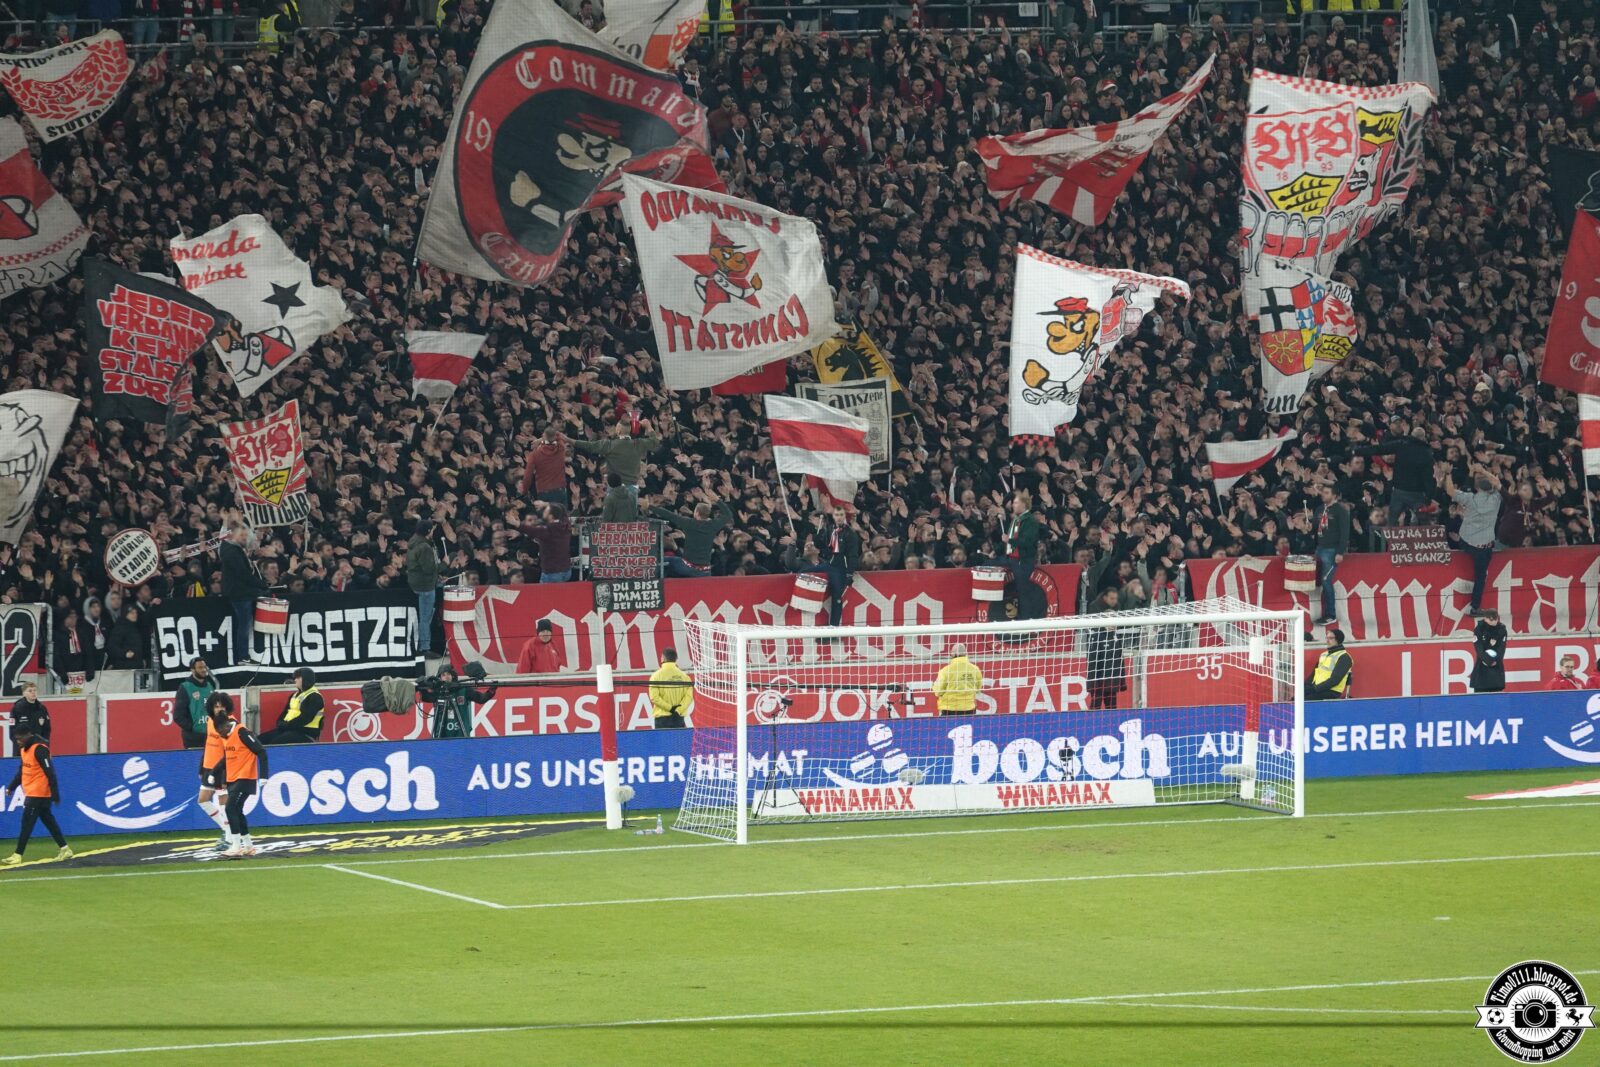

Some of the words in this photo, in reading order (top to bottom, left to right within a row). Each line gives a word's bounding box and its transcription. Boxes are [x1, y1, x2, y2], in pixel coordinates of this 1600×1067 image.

[109, 284, 215, 337] JEDER
[591, 531, 657, 546] VERBANNTE
[599, 522, 650, 533] JEDER
[1383, 528, 1423, 540] ULTRA
[1426, 528, 1447, 539] IST
[598, 546, 651, 556] KEHRT
[1391, 553, 1414, 565] UMS
[1415, 552, 1453, 564] GANZE
[613, 582, 629, 592] DU
[633, 580, 660, 591] BIST
[613, 590, 661, 602] IMMER
[613, 602, 631, 611] BEI
[635, 600, 661, 610] UNS!
[156, 616, 235, 669] 50+1
[248, 605, 419, 666] UMSETZEN
[1197, 656, 1223, 680] 35
[803, 676, 1090, 723] JOKESTAR
[160, 700, 175, 727] 3
[403, 690, 696, 741] JKERSTA
[1198, 731, 1242, 758] AU
[1416, 717, 1524, 747] HEIMAT
[947, 718, 1171, 785] bosch
[467, 762, 531, 791] AUS
[694, 749, 808, 780] HEMAT
[799, 786, 915, 815] WINAMAX
[997, 782, 1114, 809] WINAMAX
